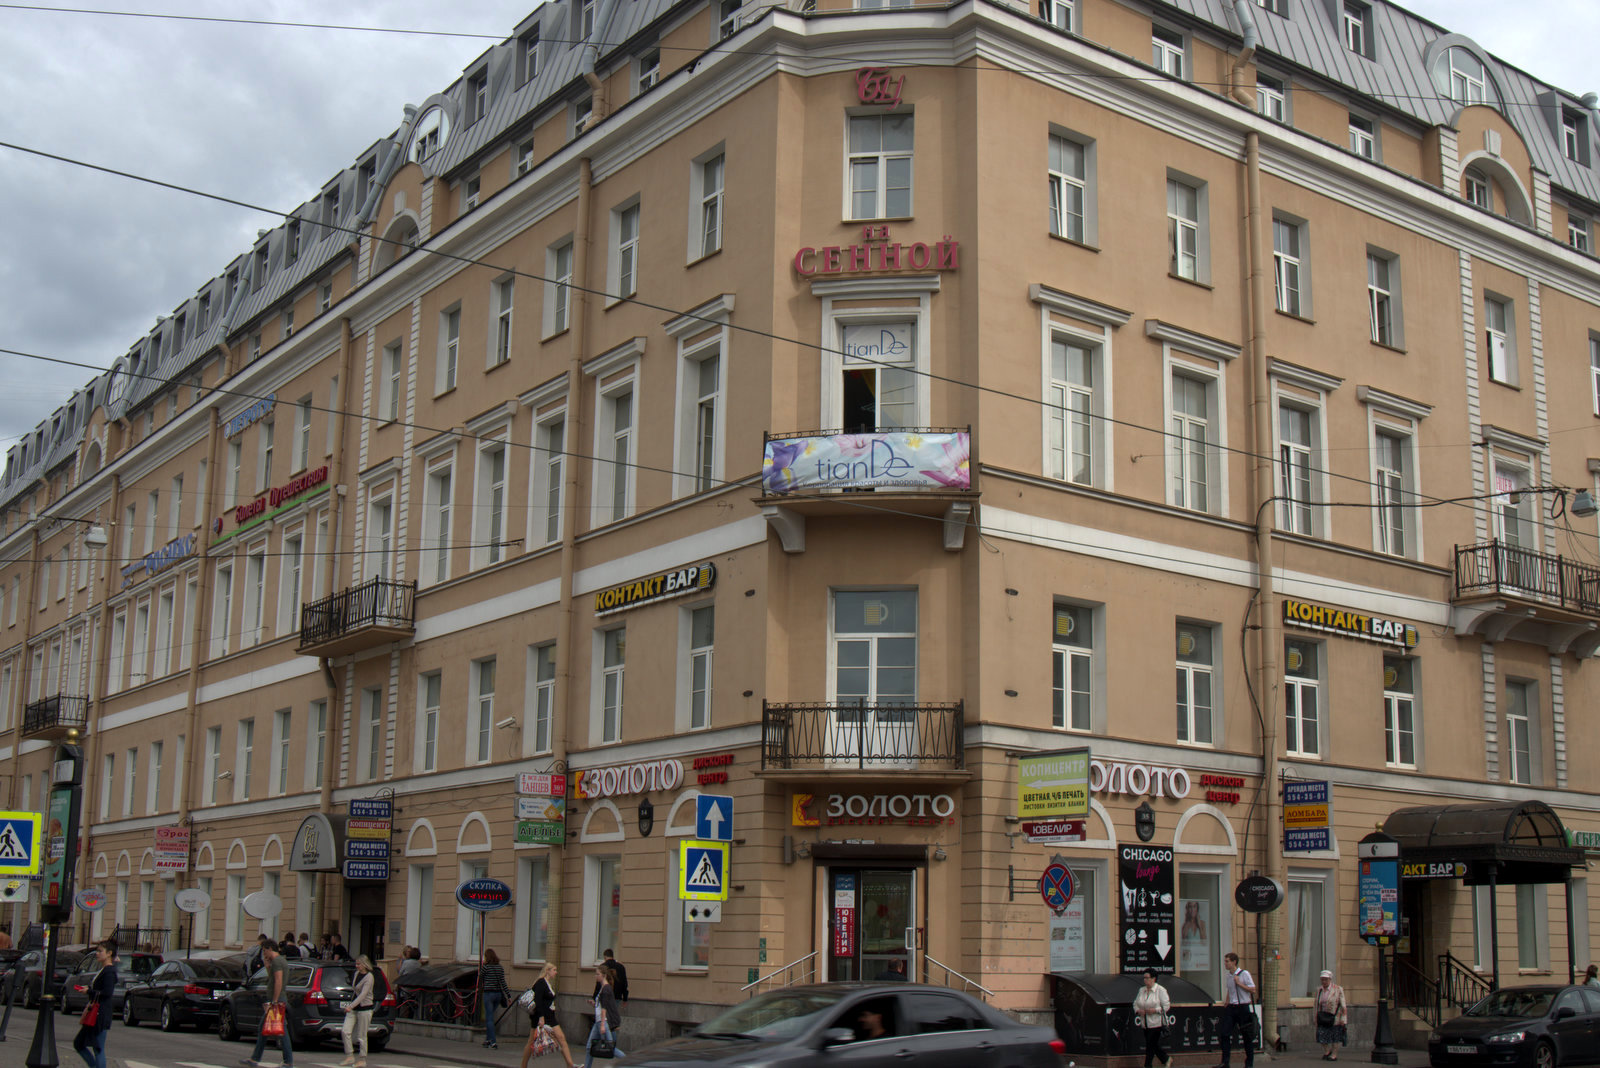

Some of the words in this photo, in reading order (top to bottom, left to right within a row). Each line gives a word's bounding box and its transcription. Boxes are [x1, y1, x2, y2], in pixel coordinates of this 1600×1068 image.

[862, 225, 890, 240] на
[795, 235, 960, 275] СЕННОЙ
[847, 329, 908, 357] tianDe
[815, 439, 915, 482] tianDe
[891, 479, 928, 487] здоровья
[235, 497, 266, 522] Билеты
[269, 465, 329, 507] Путешествия
[594, 575, 664, 611] КОНТАКТ
[666, 565, 698, 592] БАР
[1287, 600, 1369, 632] КОНТАКТ
[1371, 616, 1404, 639] БАР
[1022, 760, 1086, 777] КОПИЦЕНТР
[590, 759, 684, 799] ЗОЛОТО
[1090, 760, 1191, 799] ОЛОТО
[521, 782, 549, 793] ТАНЦЕВ
[1062, 790, 1085, 800] ПЕЧАТЬ
[1287, 785, 1307, 793] АРЕНДА
[1308, 784, 1325, 792] МЕСТА
[826, 794, 955, 817] ЗОЛОТО
[520, 826, 561, 837] АТЕЛЬЕ
[1033, 823, 1073, 835] ЮВЕЛИР
[1288, 832, 1308, 840] АРЕНДА
[1309, 831, 1326, 840] МЕСТА
[1123, 848, 1173, 862] CHICAGO
[1401, 863, 1427, 876] АКТ
[1429, 863, 1453, 874] БАР
[469, 882, 502, 890] СКУПКА
[841, 909, 849, 954] ЮВЕЛИР
